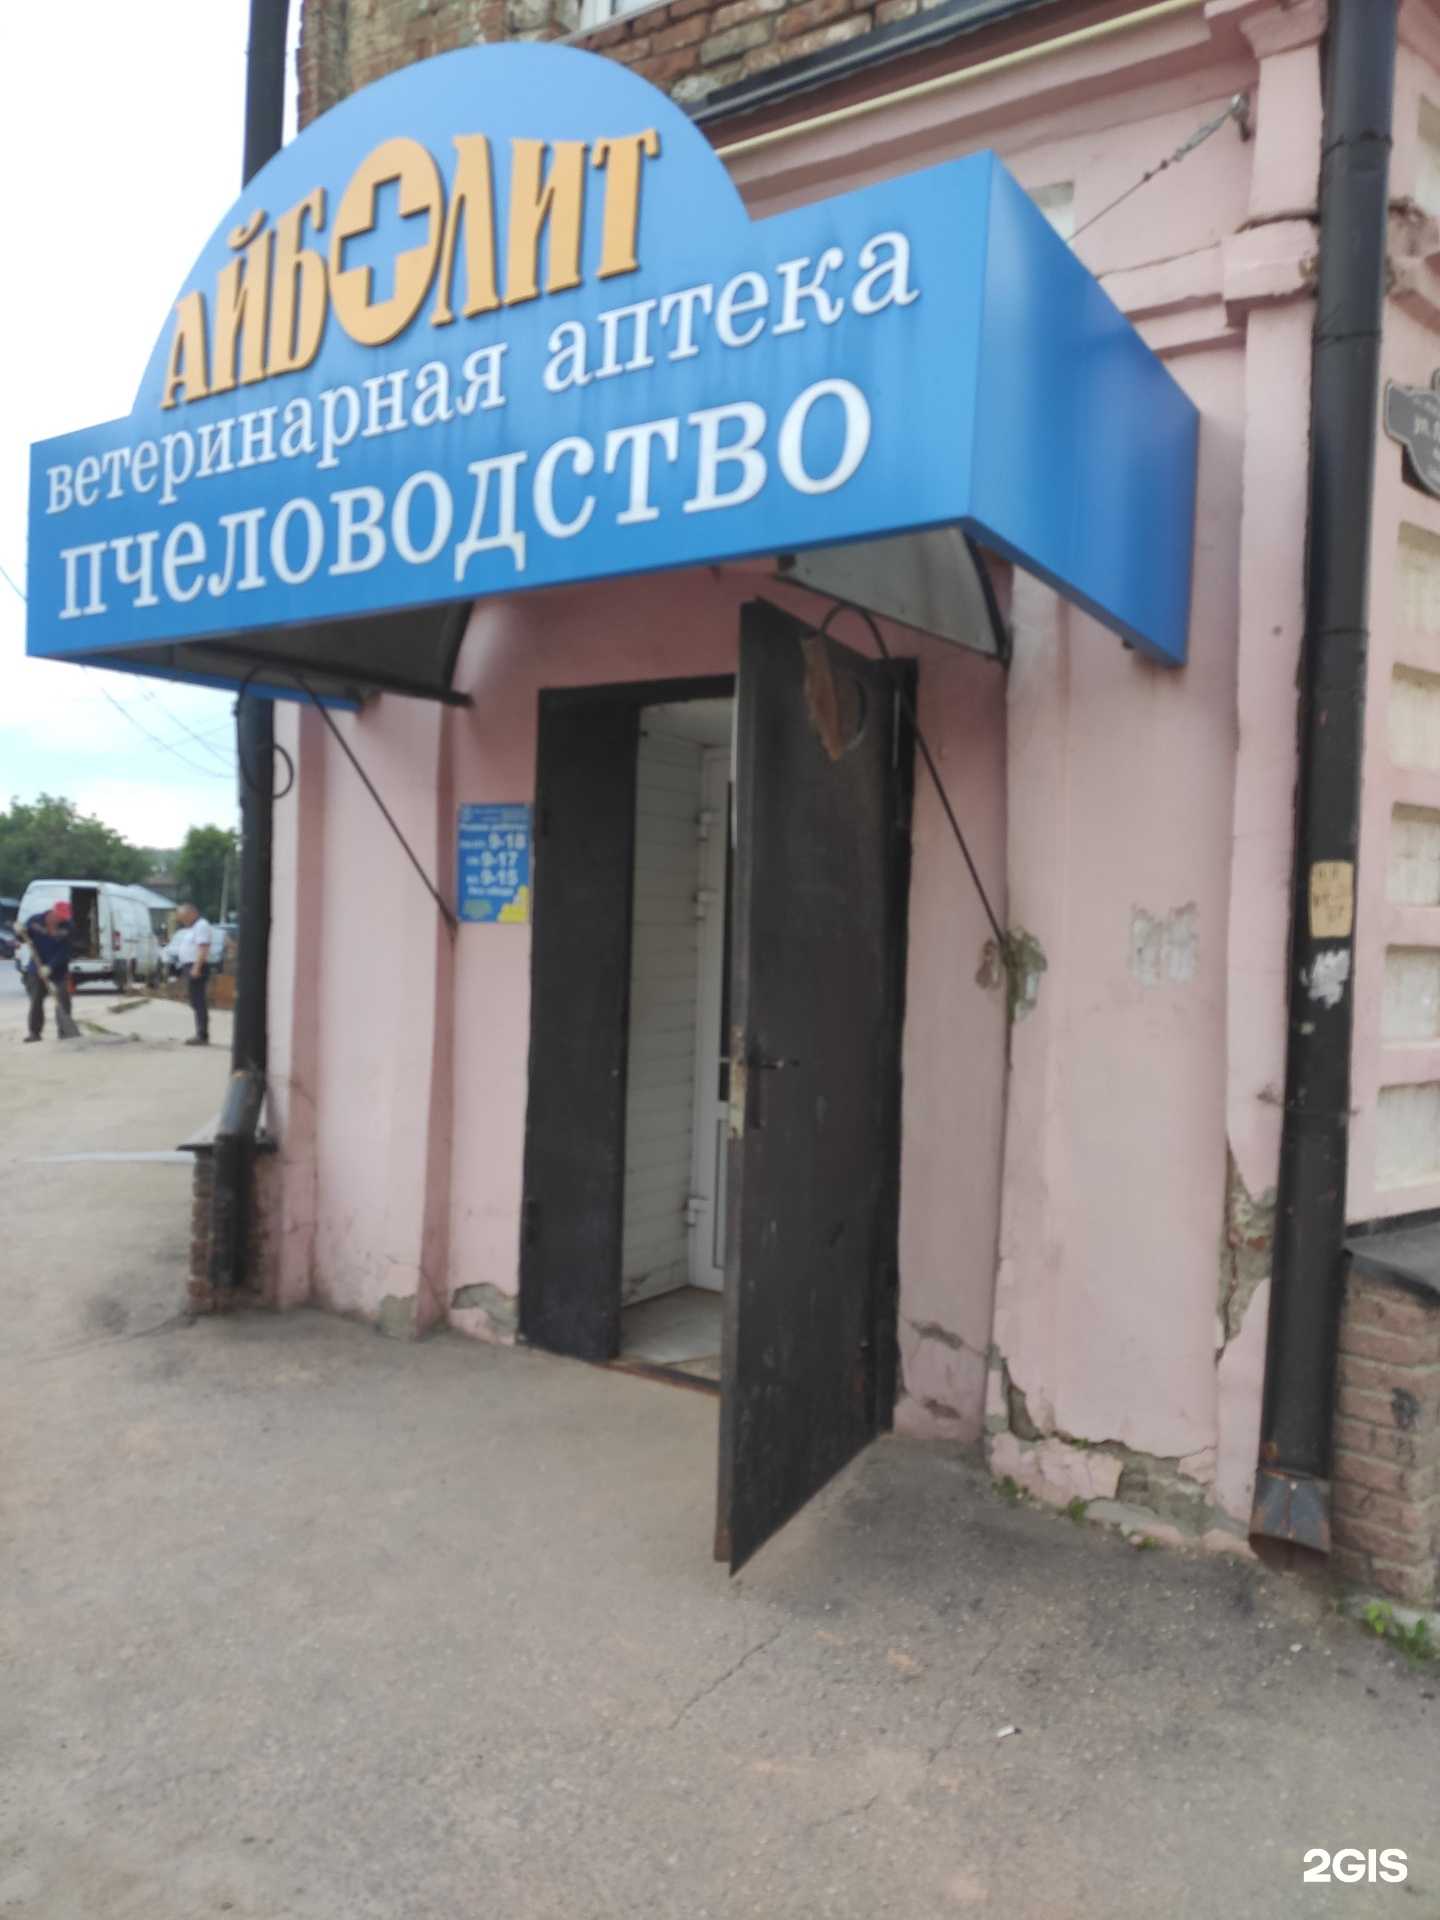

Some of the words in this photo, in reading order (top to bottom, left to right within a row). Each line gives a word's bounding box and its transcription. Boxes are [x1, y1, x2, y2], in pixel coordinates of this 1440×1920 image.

[44, 342, 508, 516] ветеринарная
[543, 230, 920, 393] аптека
[160, 127, 661, 410] АЙБОЛИТ
[59, 377, 873, 620] пчеловодство
